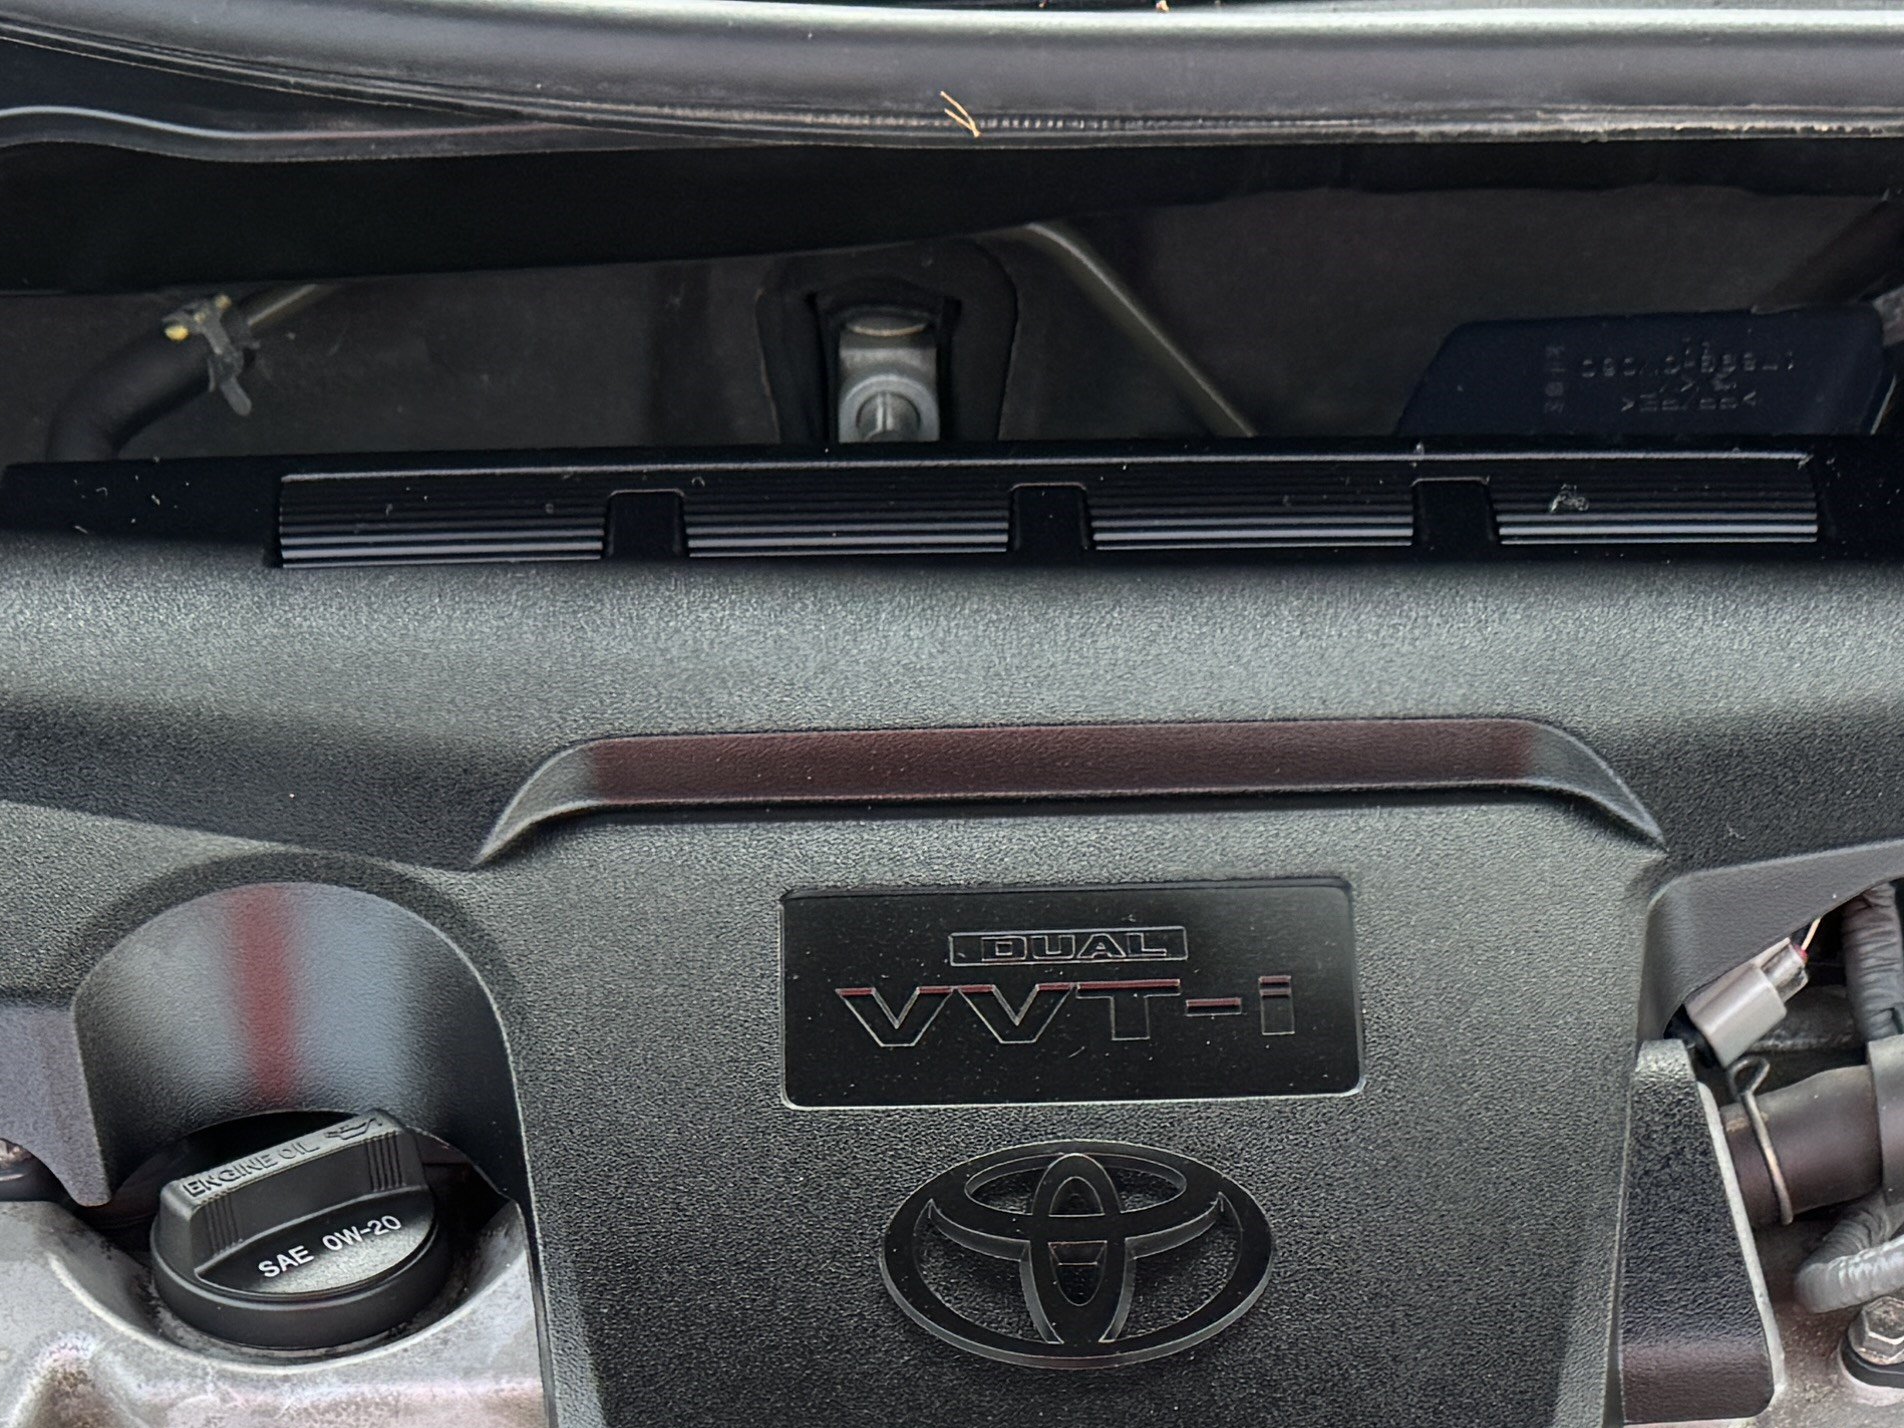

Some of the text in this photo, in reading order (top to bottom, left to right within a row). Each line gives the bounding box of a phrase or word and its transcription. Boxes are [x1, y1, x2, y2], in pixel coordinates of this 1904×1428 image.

[980, 932, 1169, 962] DUAL
[834, 975, 1296, 1048] VVT-i
[182, 1141, 321, 1198] ENGINE OIL
[258, 1215, 402, 1278] SAE 0W-20
